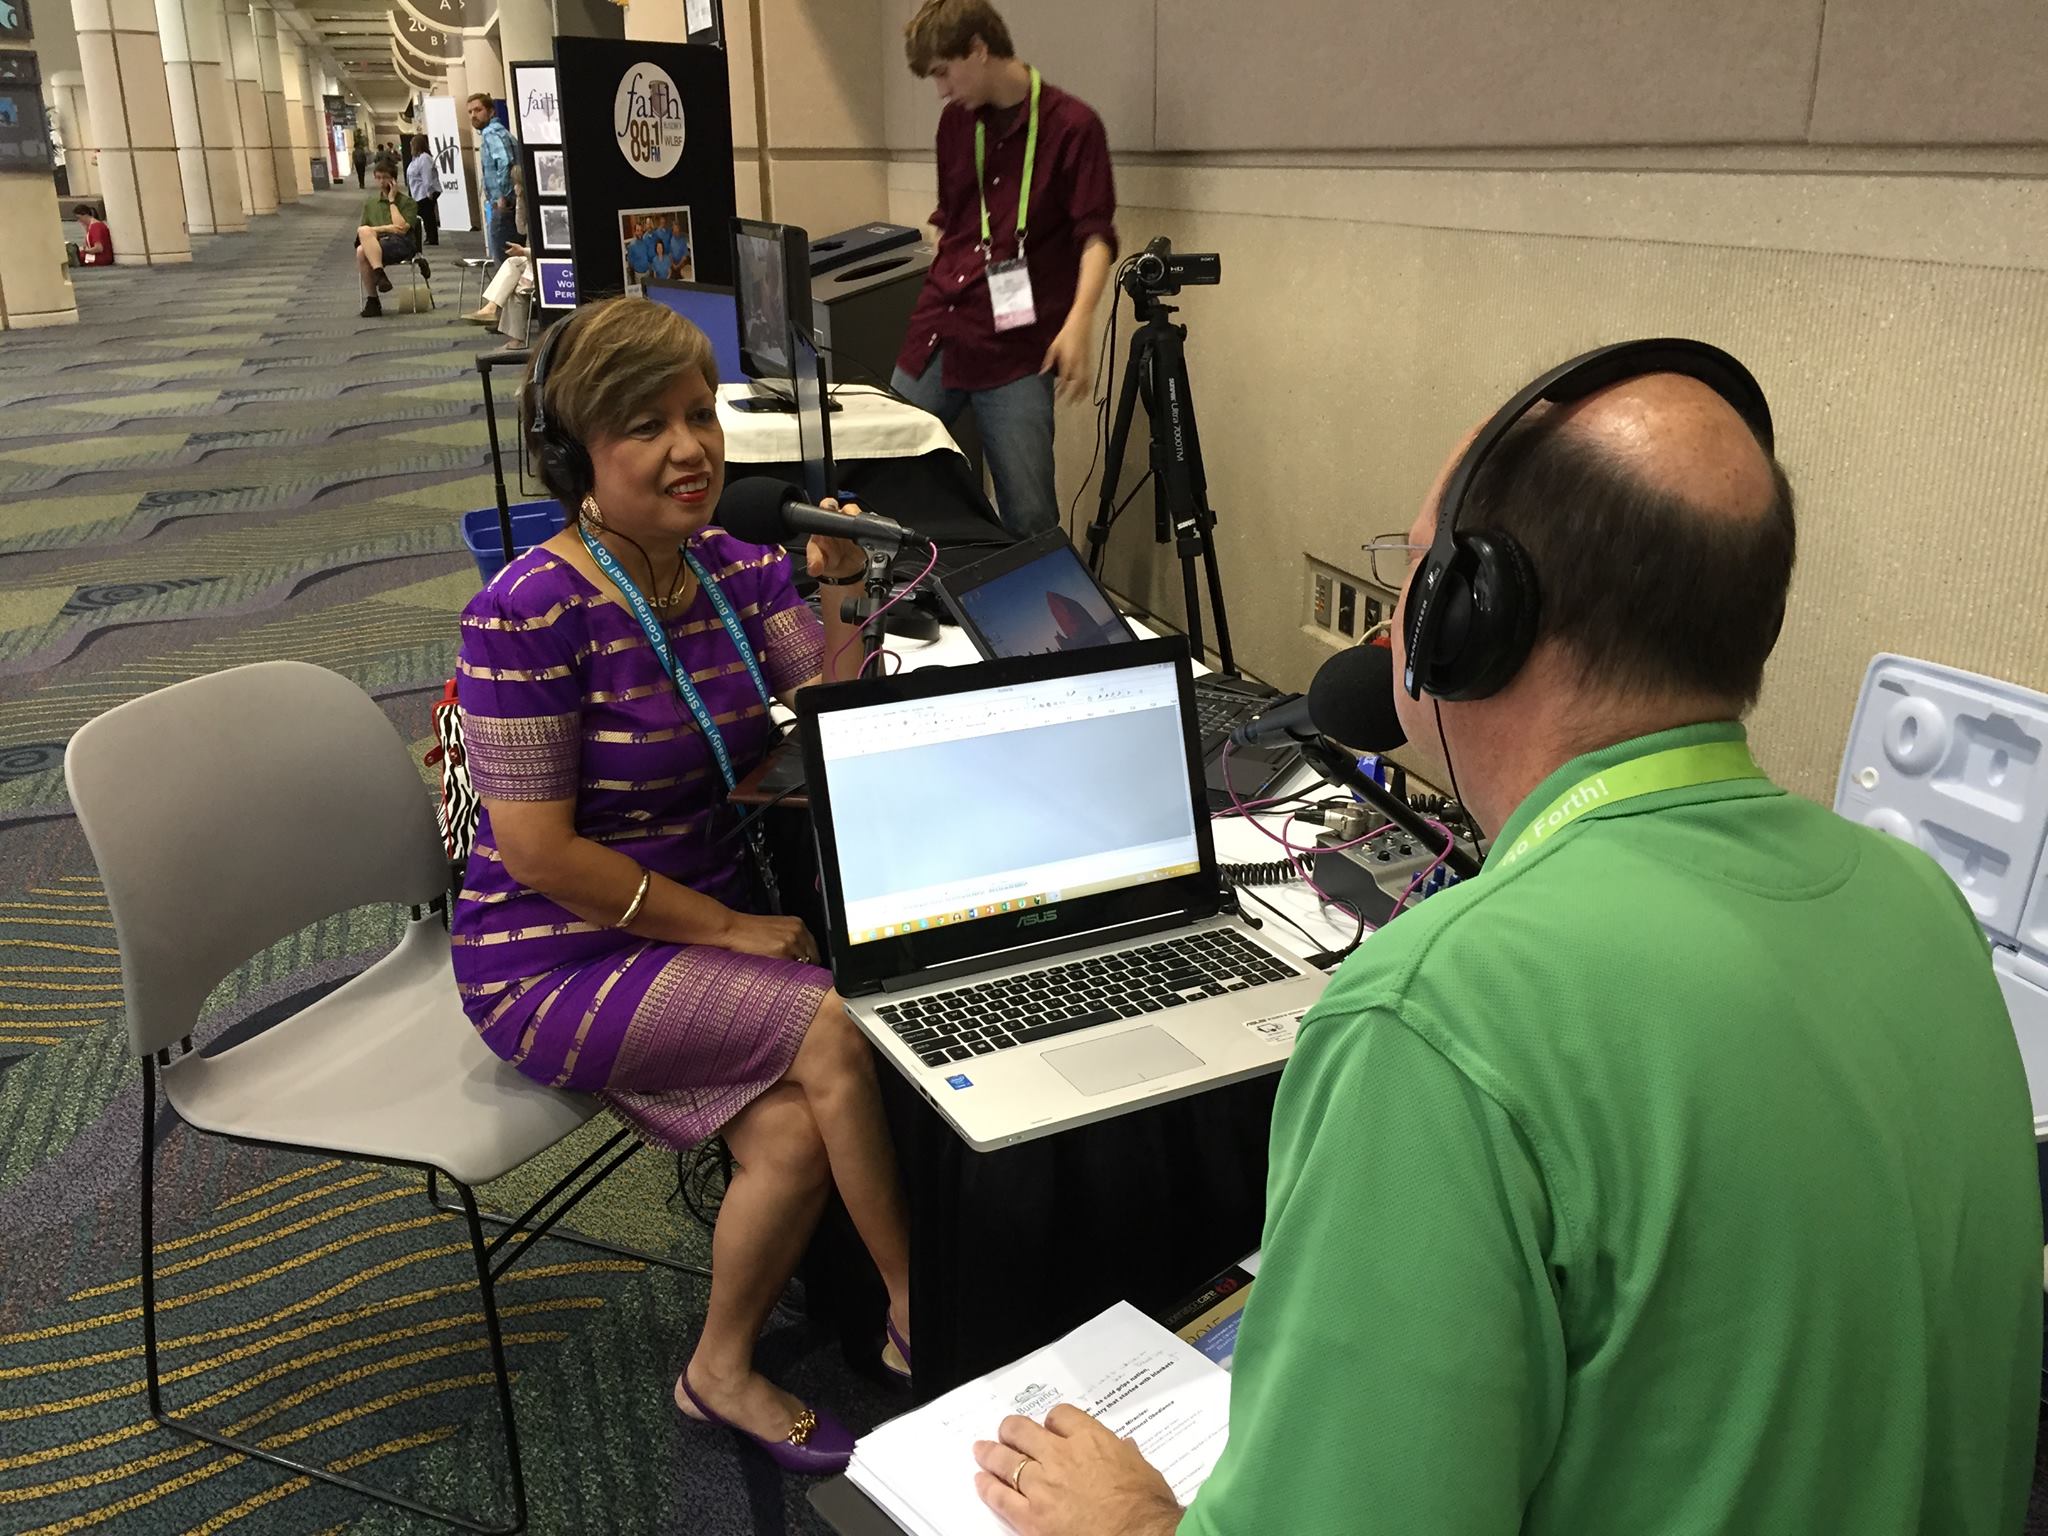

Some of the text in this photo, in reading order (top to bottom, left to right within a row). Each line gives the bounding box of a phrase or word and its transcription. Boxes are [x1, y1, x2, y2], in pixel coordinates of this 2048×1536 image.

[618, 73, 680, 137] faith
[630, 119, 660, 162] 89.1
[597, 547, 612, 565] Go
[609, 566, 661, 642] Courageous!
[704, 576, 729, 616] Strong
[726, 617, 744, 639] and
[675, 668, 700, 710] Strong
[699, 711, 711, 728] Be
[708, 729, 729, 771] Ready!
[1533, 778, 1609, 839] Forth!
[1016, 909, 1058, 928] ASUS
[1016, 1387, 1059, 1414] Buoyancy
[1106, 1398, 1119, 1408] that
[1119, 1384, 1139, 1400] started
[1139, 1376, 1151, 1385] with
[1150, 1361, 1174, 1377] blankets
